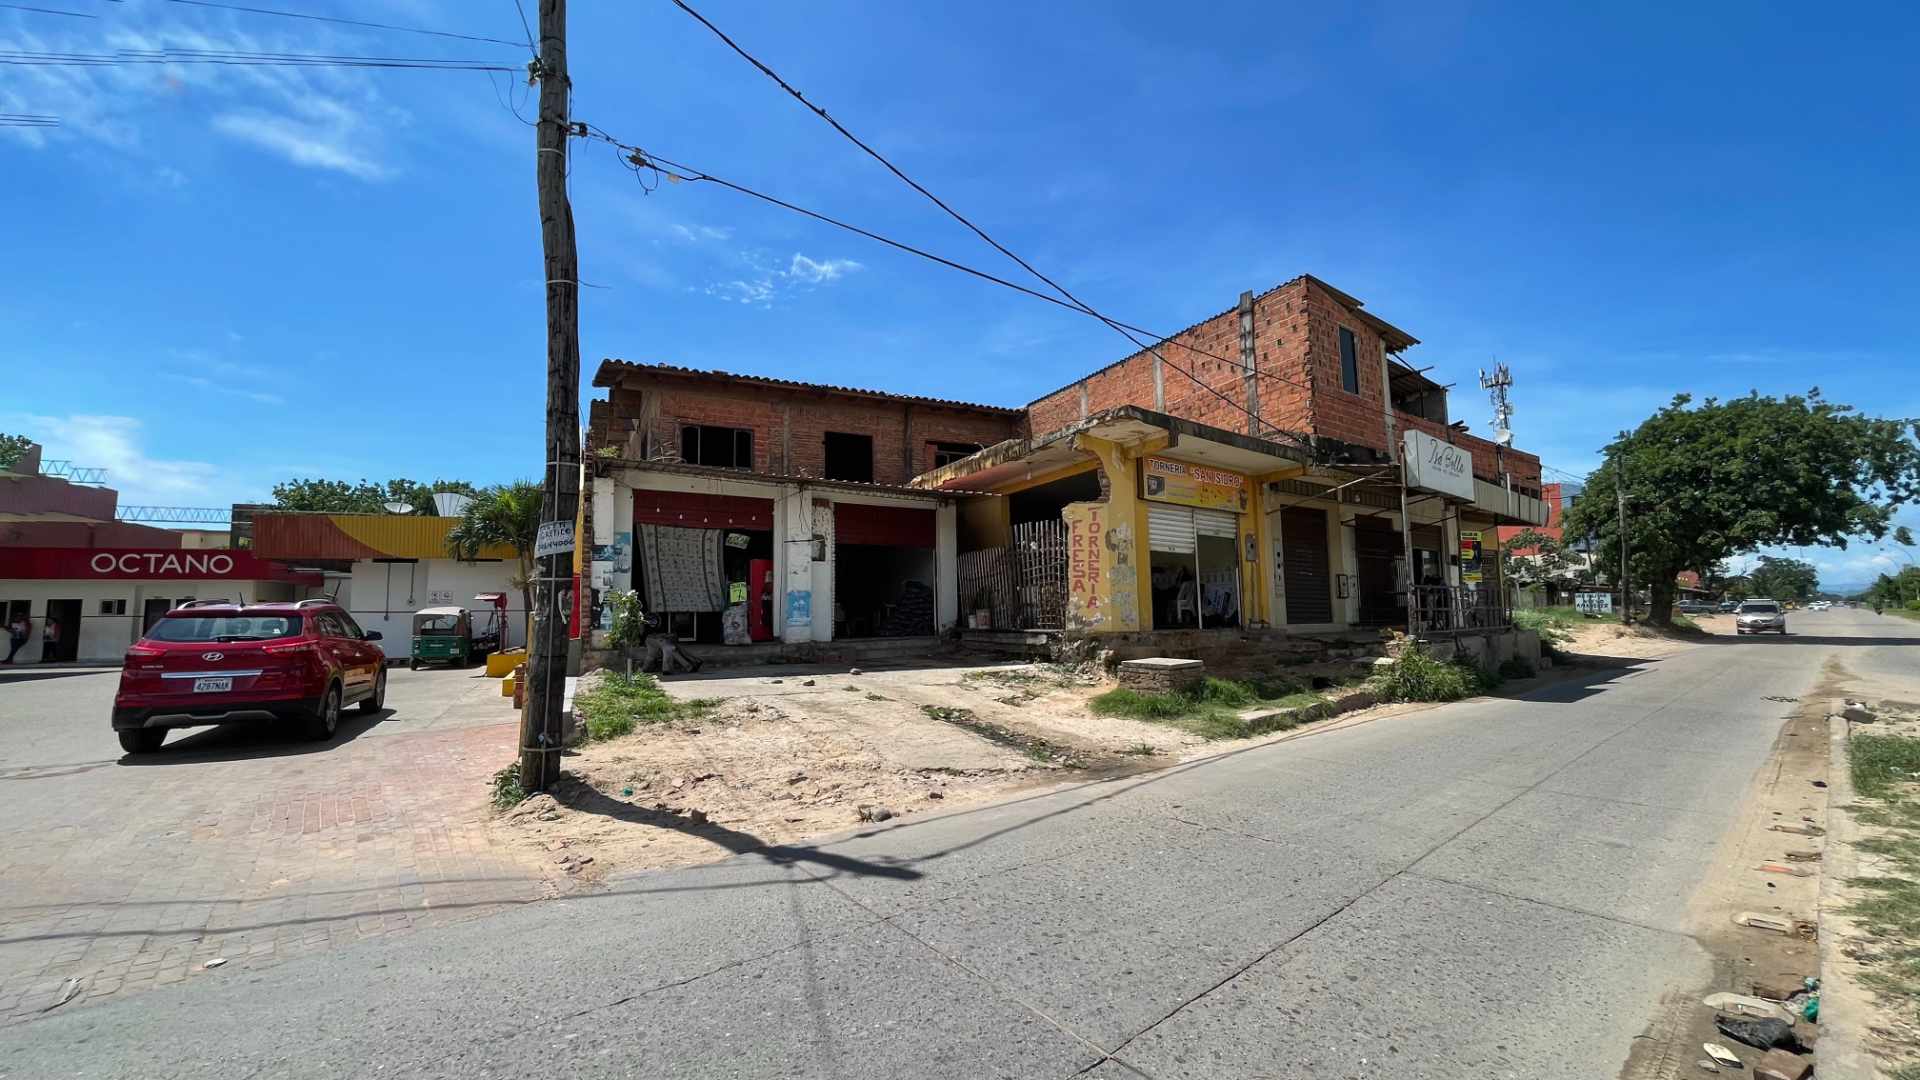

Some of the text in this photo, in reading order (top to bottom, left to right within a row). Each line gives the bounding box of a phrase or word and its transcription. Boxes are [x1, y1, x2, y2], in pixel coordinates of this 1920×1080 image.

[1148, 459, 1185, 475] TORNERIA
[91, 553, 234, 574] OCTANO
[1072, 519, 1086, 593] FRESA
[1088, 506, 1104, 609] TORNERIA
